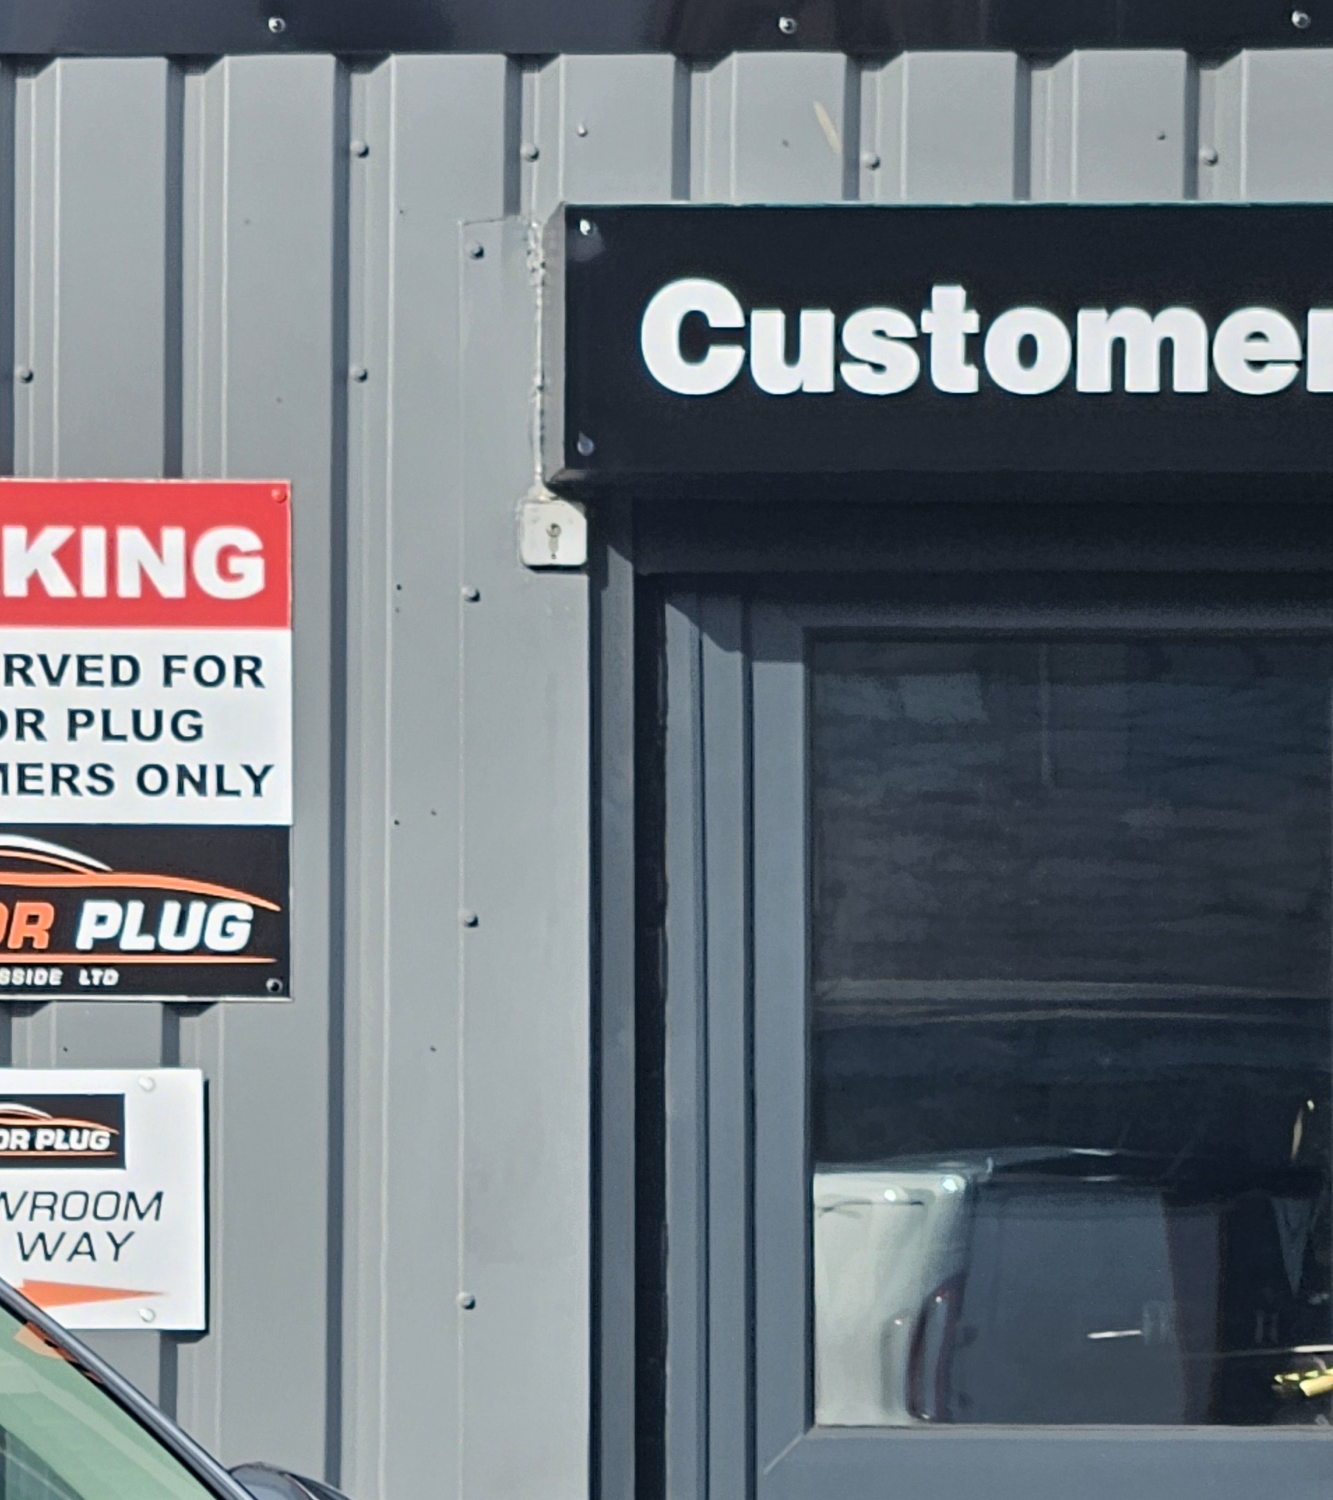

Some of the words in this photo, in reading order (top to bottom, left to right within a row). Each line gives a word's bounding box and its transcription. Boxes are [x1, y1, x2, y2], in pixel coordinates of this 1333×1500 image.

[162, 654, 266, 689] FOR
[67, 708, 205, 742] PLUG
[136, 762, 275, 798] ONLY
[75, 900, 254, 951] PLUG
[78, 969, 119, 987] LTD
[34, 1128, 111, 1152] PLUG
[16, 1231, 136, 1262] WAY
